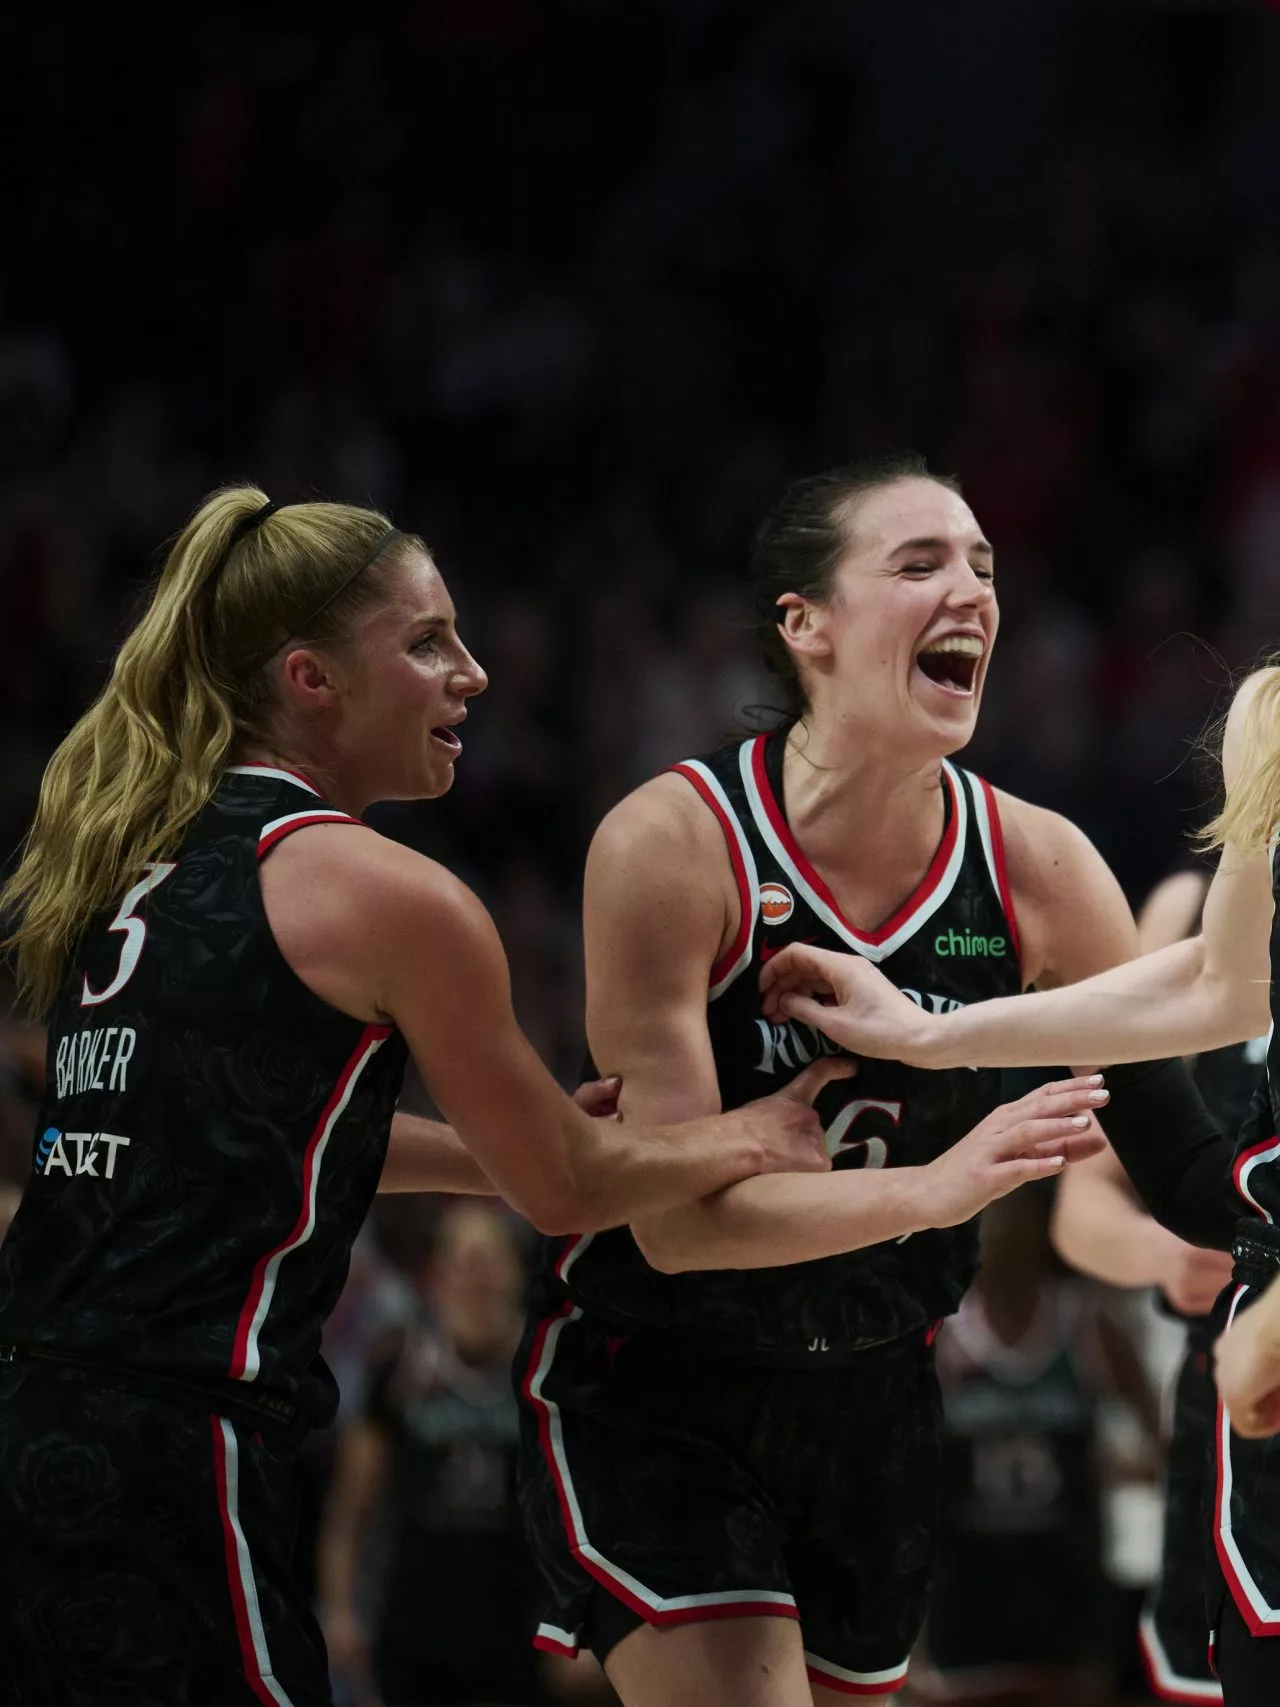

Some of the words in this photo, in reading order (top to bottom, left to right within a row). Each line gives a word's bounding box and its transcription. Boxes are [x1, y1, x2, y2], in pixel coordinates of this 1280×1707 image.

[80, 861, 177, 1007] 3
[934, 928, 1006, 957] chime
[56, 1027, 136, 1099] BARKER
[44, 1132, 130, 1179] AT&T
